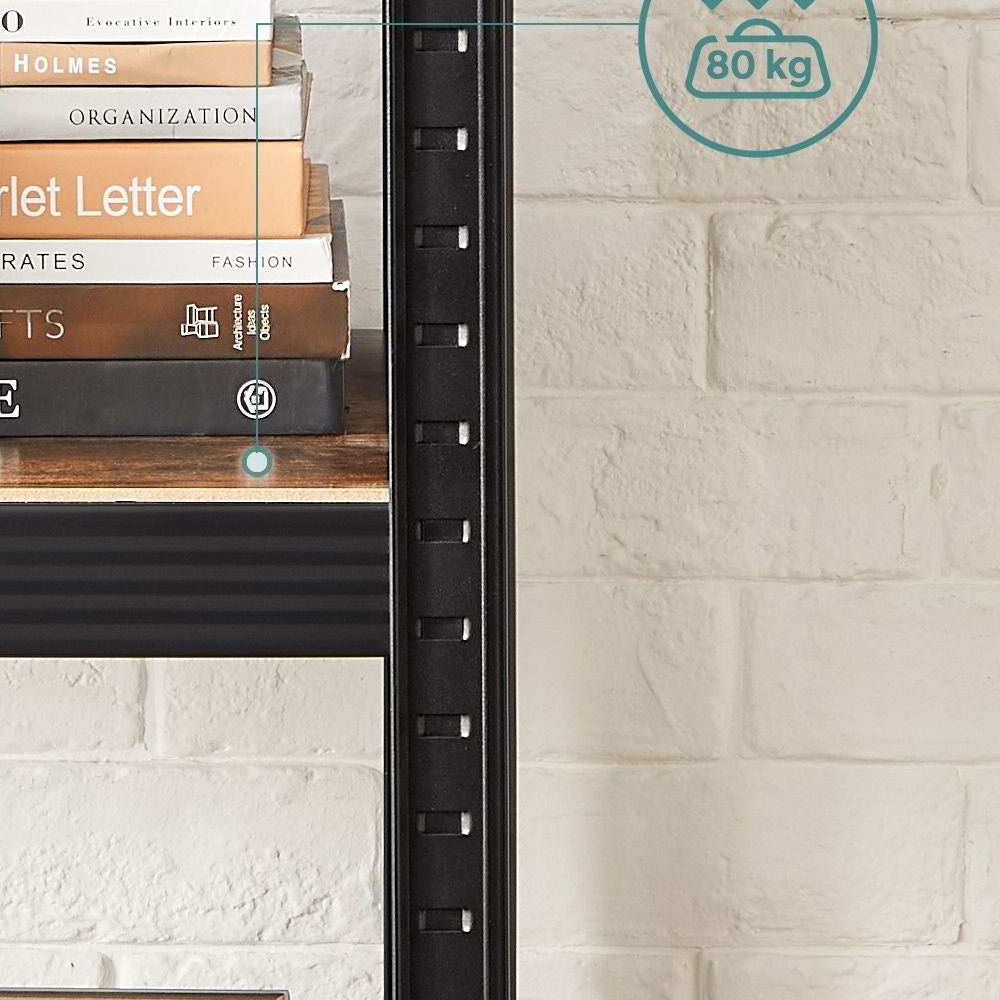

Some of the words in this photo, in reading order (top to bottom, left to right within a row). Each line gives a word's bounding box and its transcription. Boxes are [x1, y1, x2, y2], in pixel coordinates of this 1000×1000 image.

[86, 16, 160, 27] Evocative
[168, 16, 238, 27] Interiors
[13, 53, 118, 74] HOLMES
[69, 107, 259, 127] ORGANIZATION
[76, 175, 202, 218] Letter
[212, 255, 293, 269] FASHION
